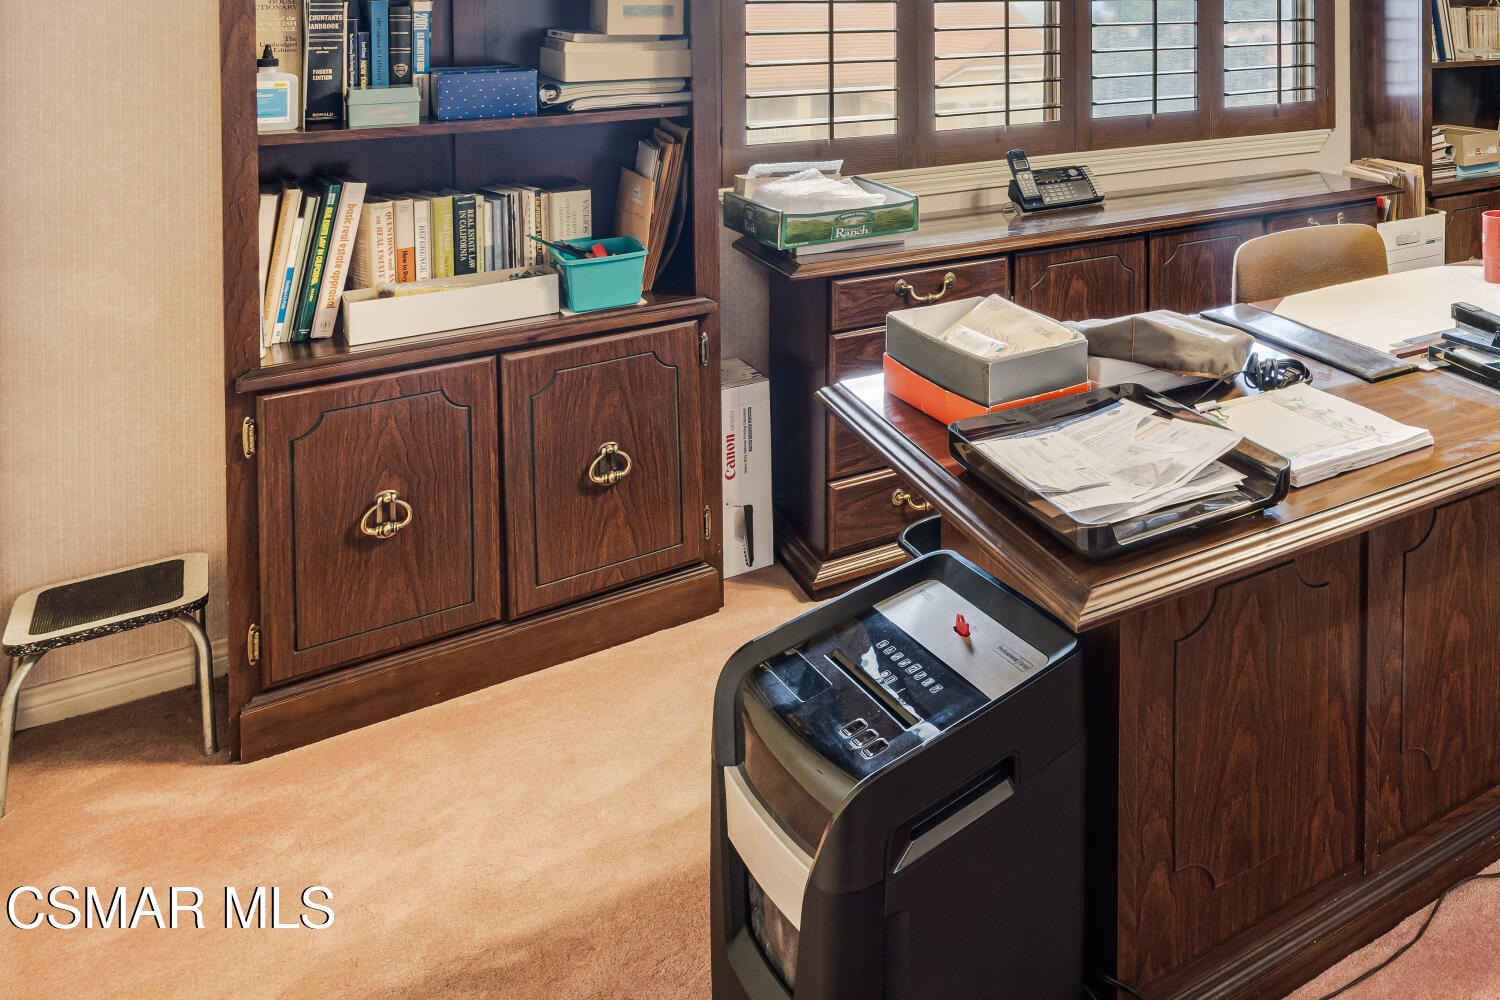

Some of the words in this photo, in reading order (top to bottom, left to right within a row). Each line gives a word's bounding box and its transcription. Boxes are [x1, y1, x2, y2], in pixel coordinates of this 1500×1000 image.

[413, 13, 428, 30] 2001
[323, 206, 333, 220] REAL
[343, 203, 358, 225] basic
[376, 216, 382, 225] on
[459, 210, 467, 218] IN
[467, 208, 475, 227] REAL
[320, 219, 331, 236] ESTATE
[340, 225, 350, 242] real
[385, 211, 394, 256] QUESTIONS
[835, 224, 870, 239] Ranch
[318, 236, 327, 248] LAW
[376, 227, 386, 248] REAL
[459, 219, 468, 261] CALIFORNIA
[467, 229, 475, 253] ESTATE
[334, 243, 347, 269] estate
[376, 250, 387, 280] ESTATE
[468, 254, 476, 268] LAW
[401, 271, 409, 282] Buy
[325, 269, 343, 309] appraisal
[724, 433, 736, 481] Canon
